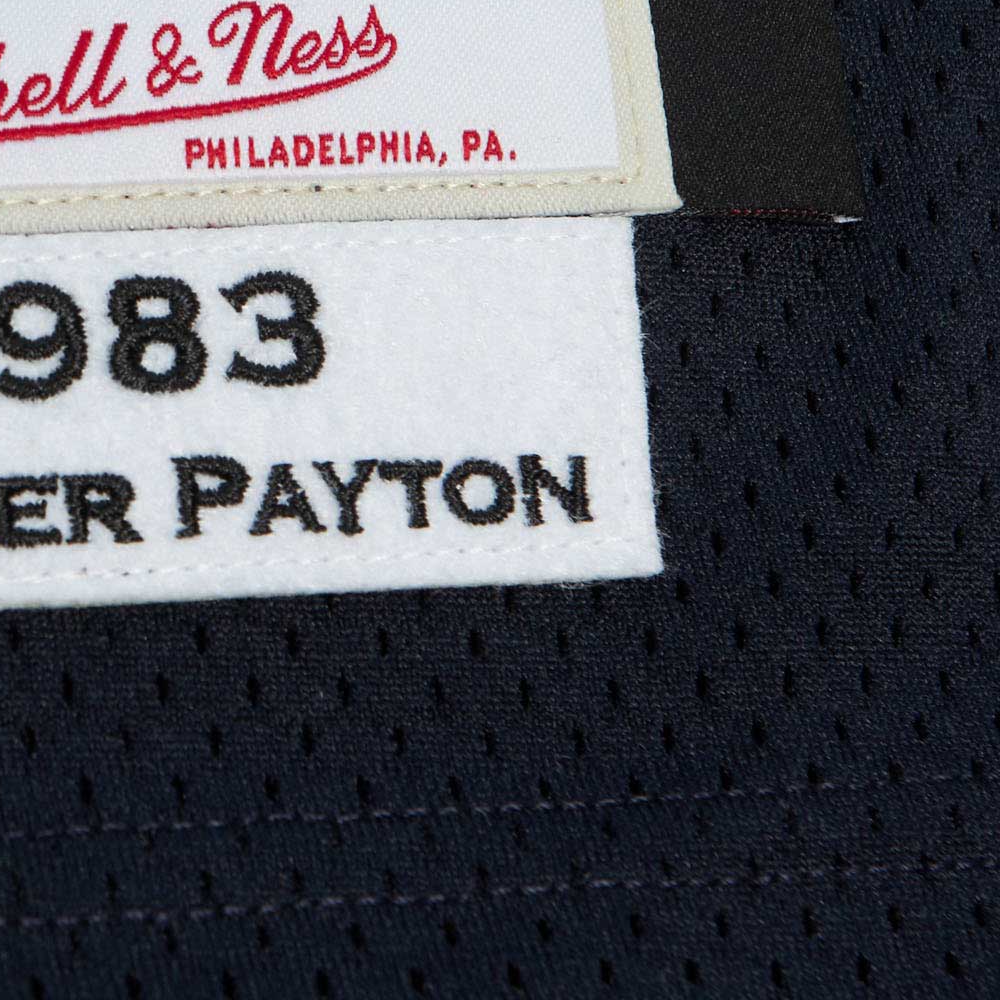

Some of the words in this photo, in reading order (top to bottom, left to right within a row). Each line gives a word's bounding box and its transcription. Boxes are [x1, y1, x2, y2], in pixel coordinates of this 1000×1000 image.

[146, 23, 202, 88] &
[208, 1, 398, 86] Ness
[185, 131, 447, 169] PHILADELPHIA,
[462, 130, 516, 161] PA.
[170, 453, 594, 540] PAYTON
